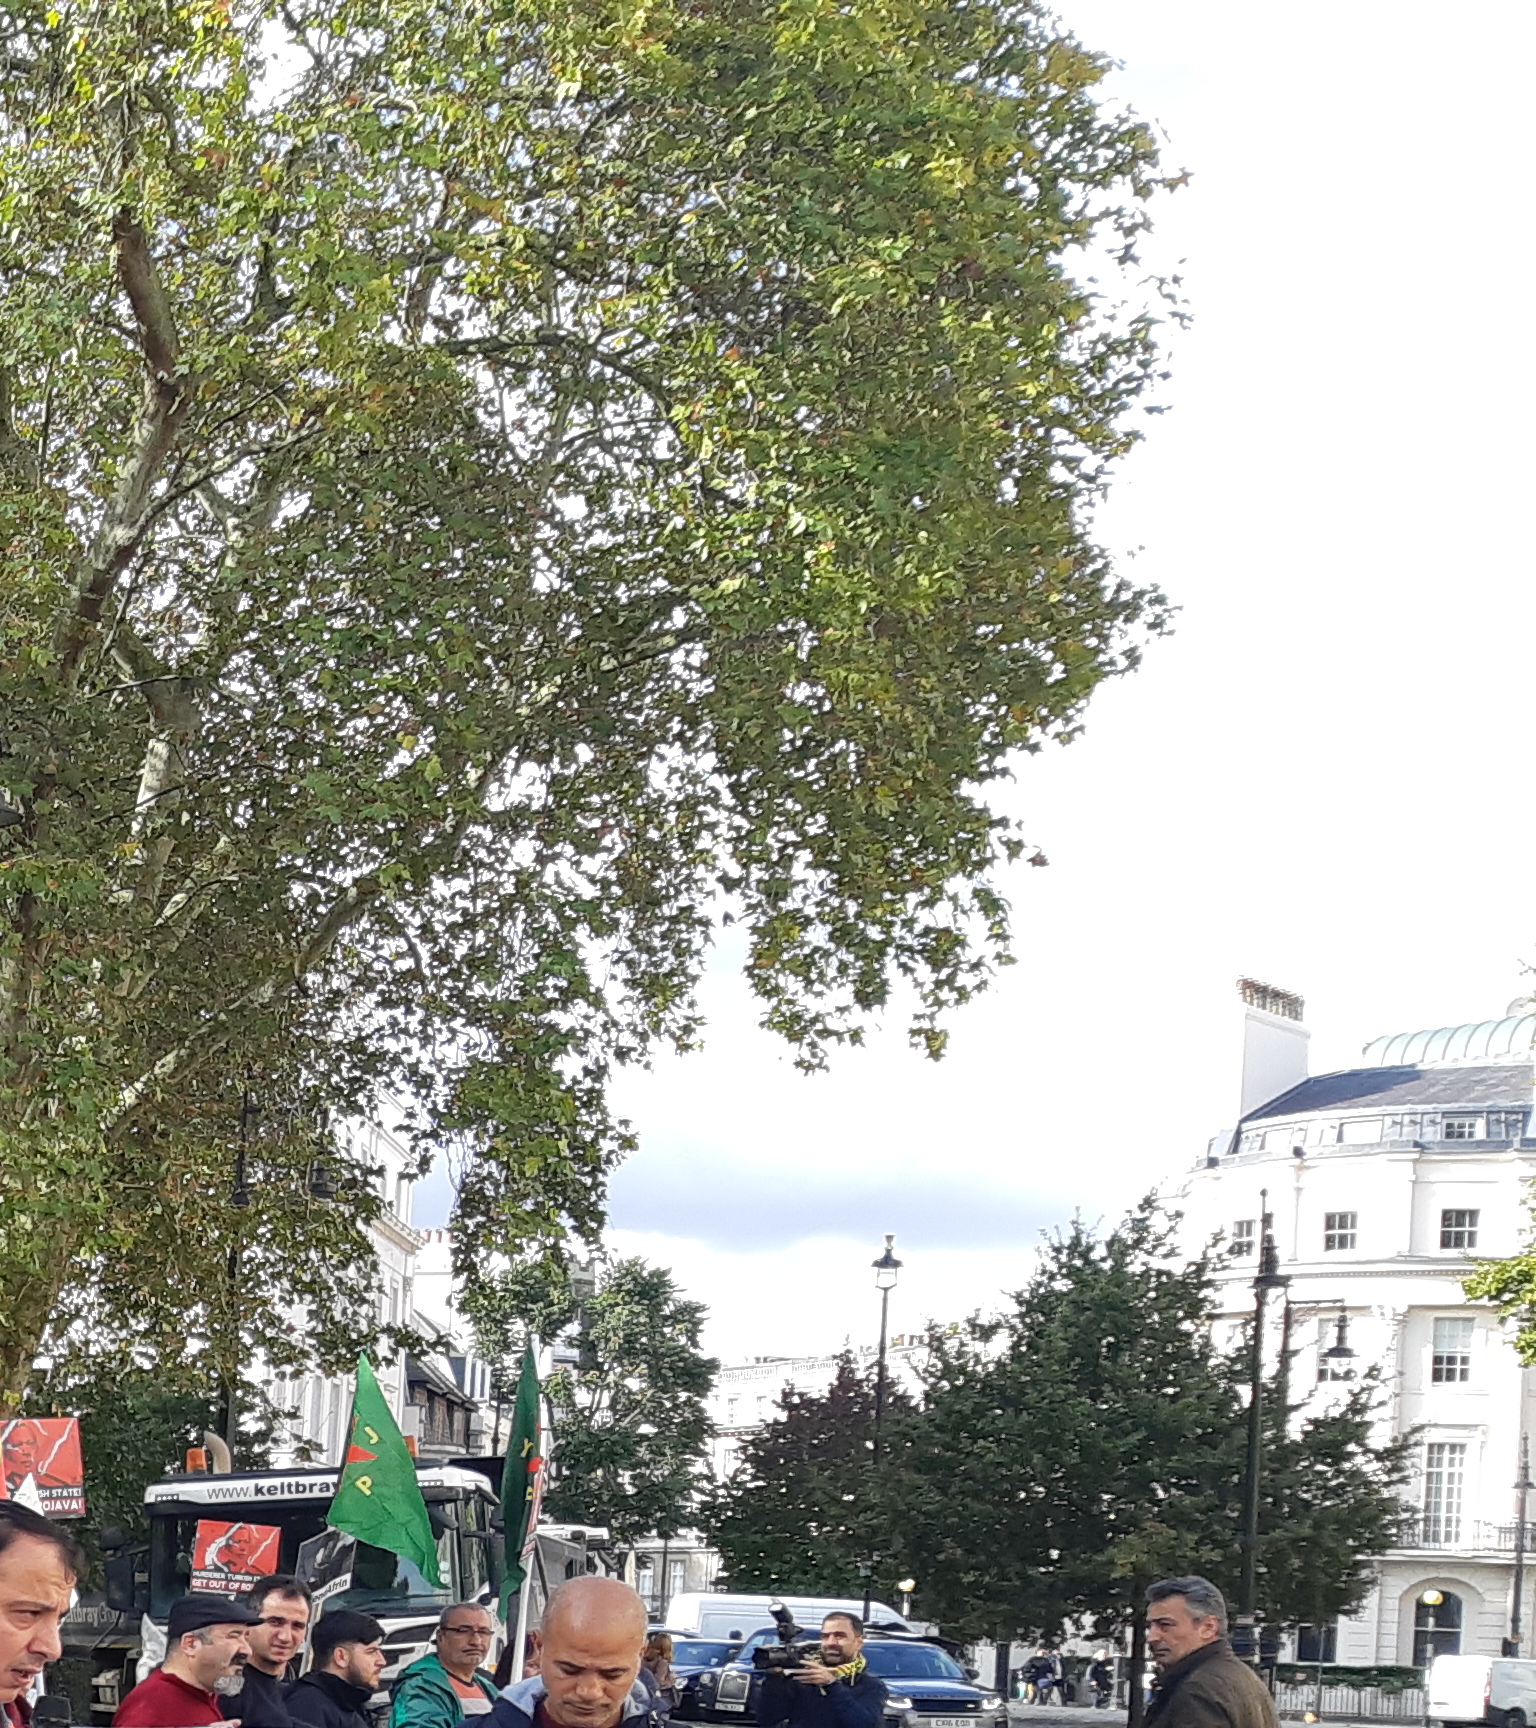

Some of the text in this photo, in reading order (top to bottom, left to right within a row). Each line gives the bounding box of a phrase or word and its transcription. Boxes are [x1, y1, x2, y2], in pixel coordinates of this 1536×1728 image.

[42, 1499, 83, 1512] OJAVA!
[192, 1579, 208, 1587] GET
[208, 1580, 227, 1589] OUT
[228, 1582, 241, 1590] OF
